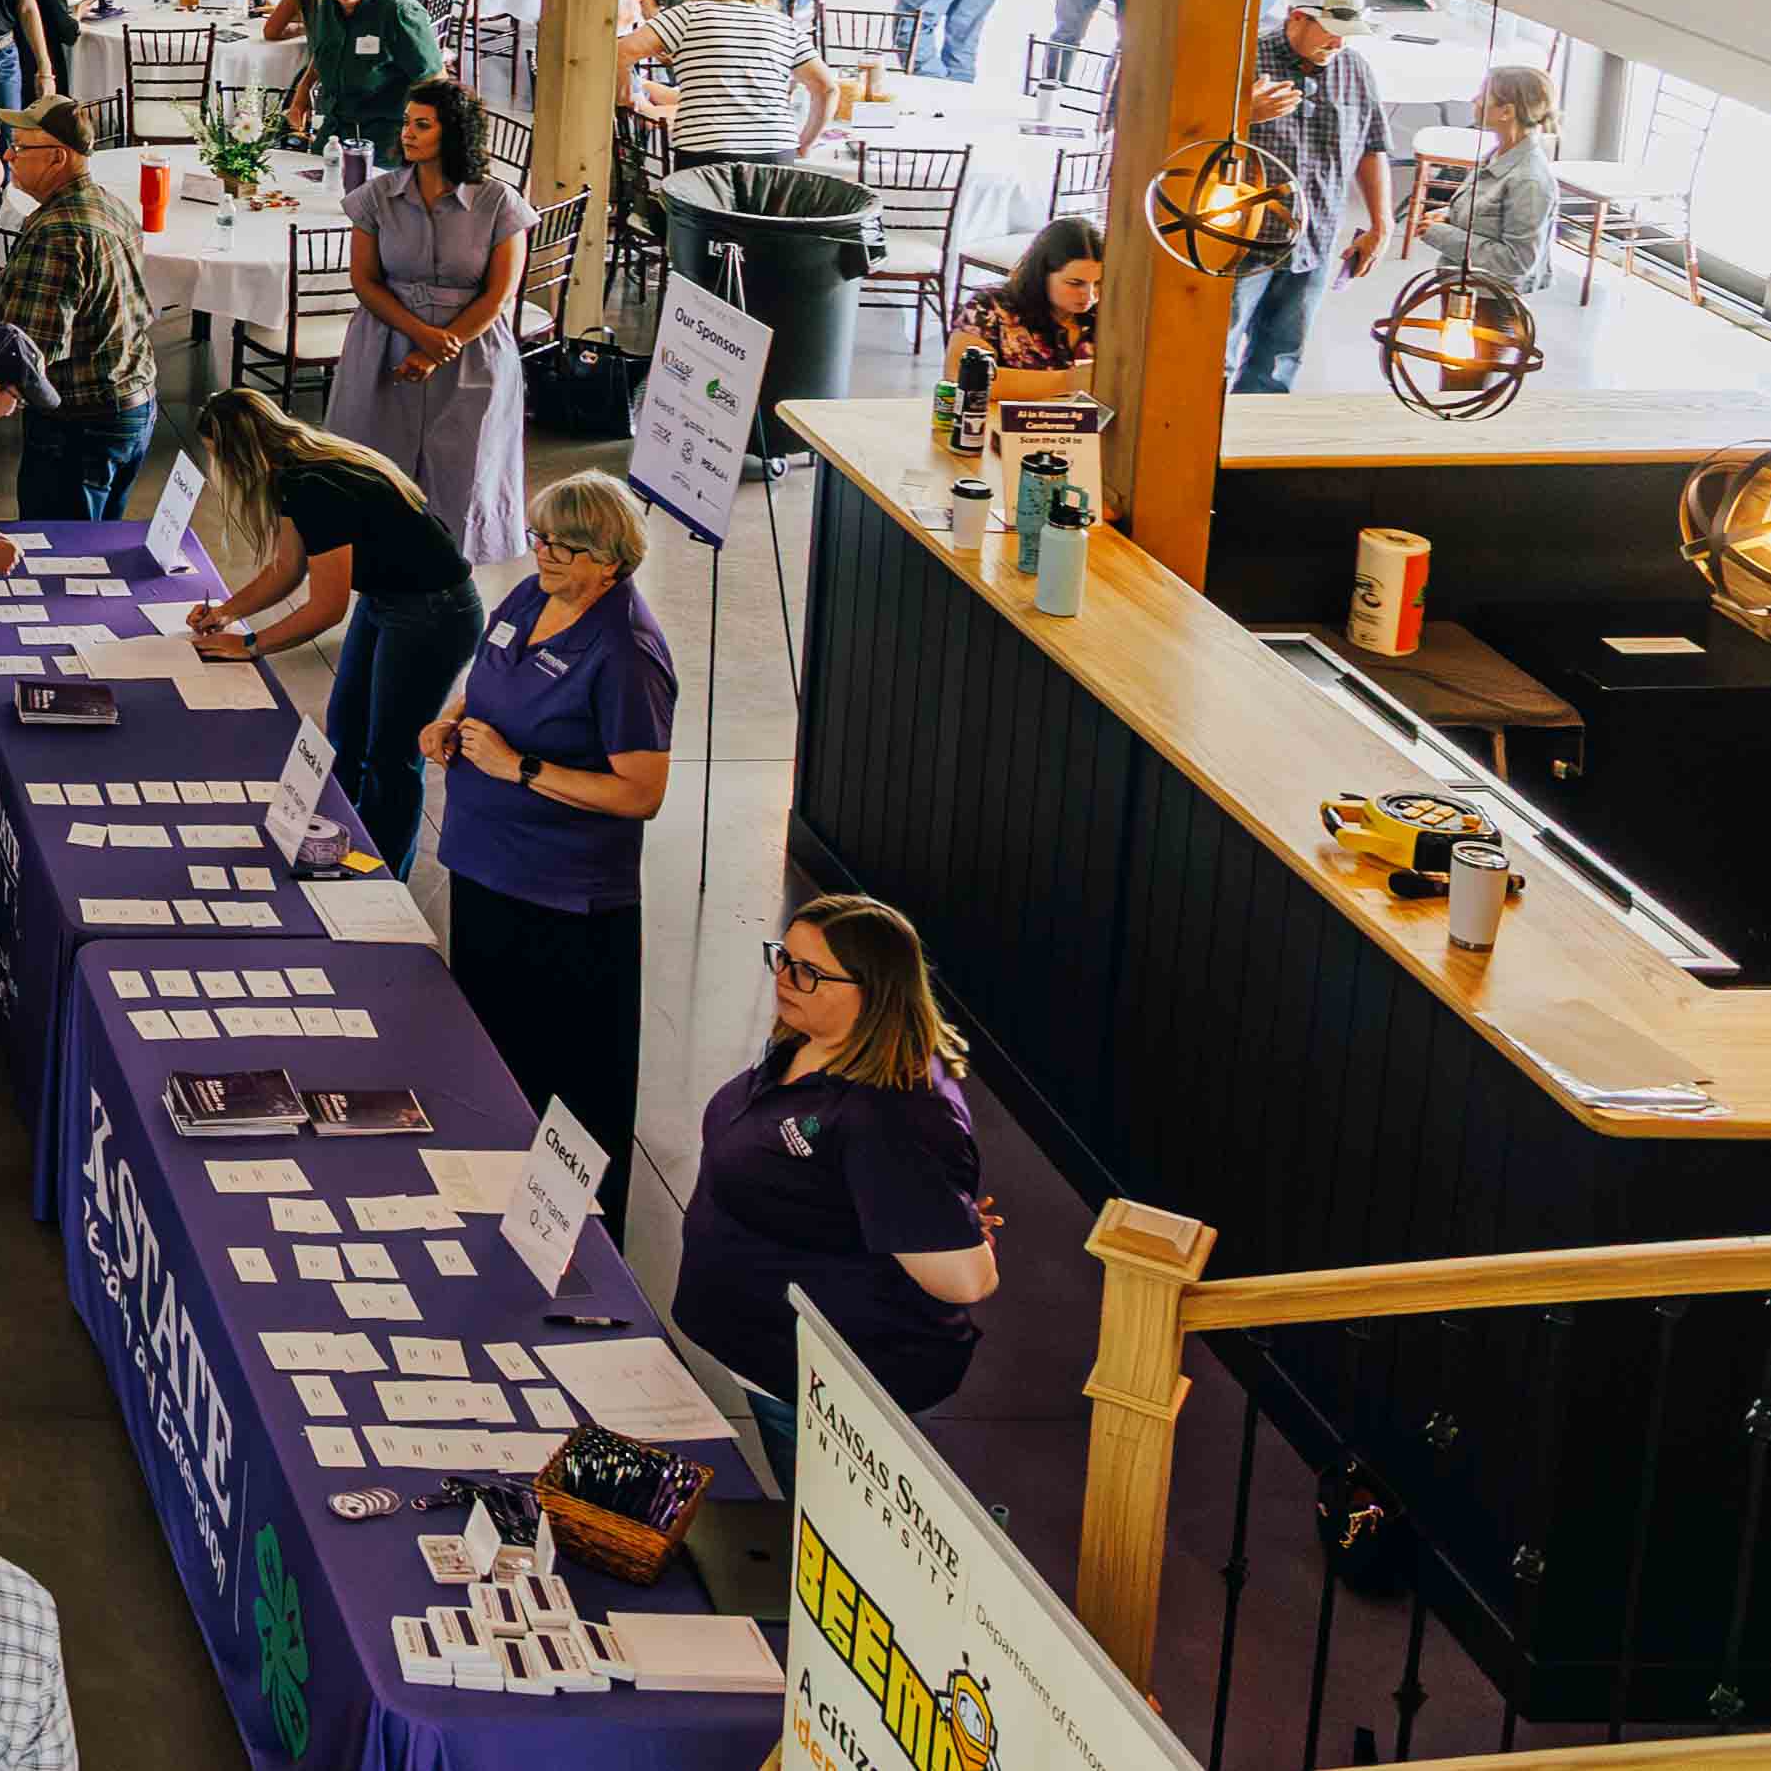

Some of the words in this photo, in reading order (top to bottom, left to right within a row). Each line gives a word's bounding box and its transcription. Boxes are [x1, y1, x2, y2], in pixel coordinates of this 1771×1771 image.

[675, 306, 695, 329] Our
[696, 320, 747, 361] Sponsors
[1041, 436, 1057, 445] the
[298, 738, 317, 771] Check
[545, 1127, 578, 1176] Check
[576, 1164, 591, 1189] In
[527, 1173, 547, 1204] Last
[543, 1196, 571, 1232] name
[157, 1391, 226, 1598] Extension
[808, 1365, 890, 1491] KANSAS
[896, 1473, 960, 1580] STATE
[806, 1409, 956, 1607] UNIVERSITY
[800, 1667, 812, 1710] A
[976, 1604, 1051, 1709] Department
[1052, 1705, 1066, 1726] of
